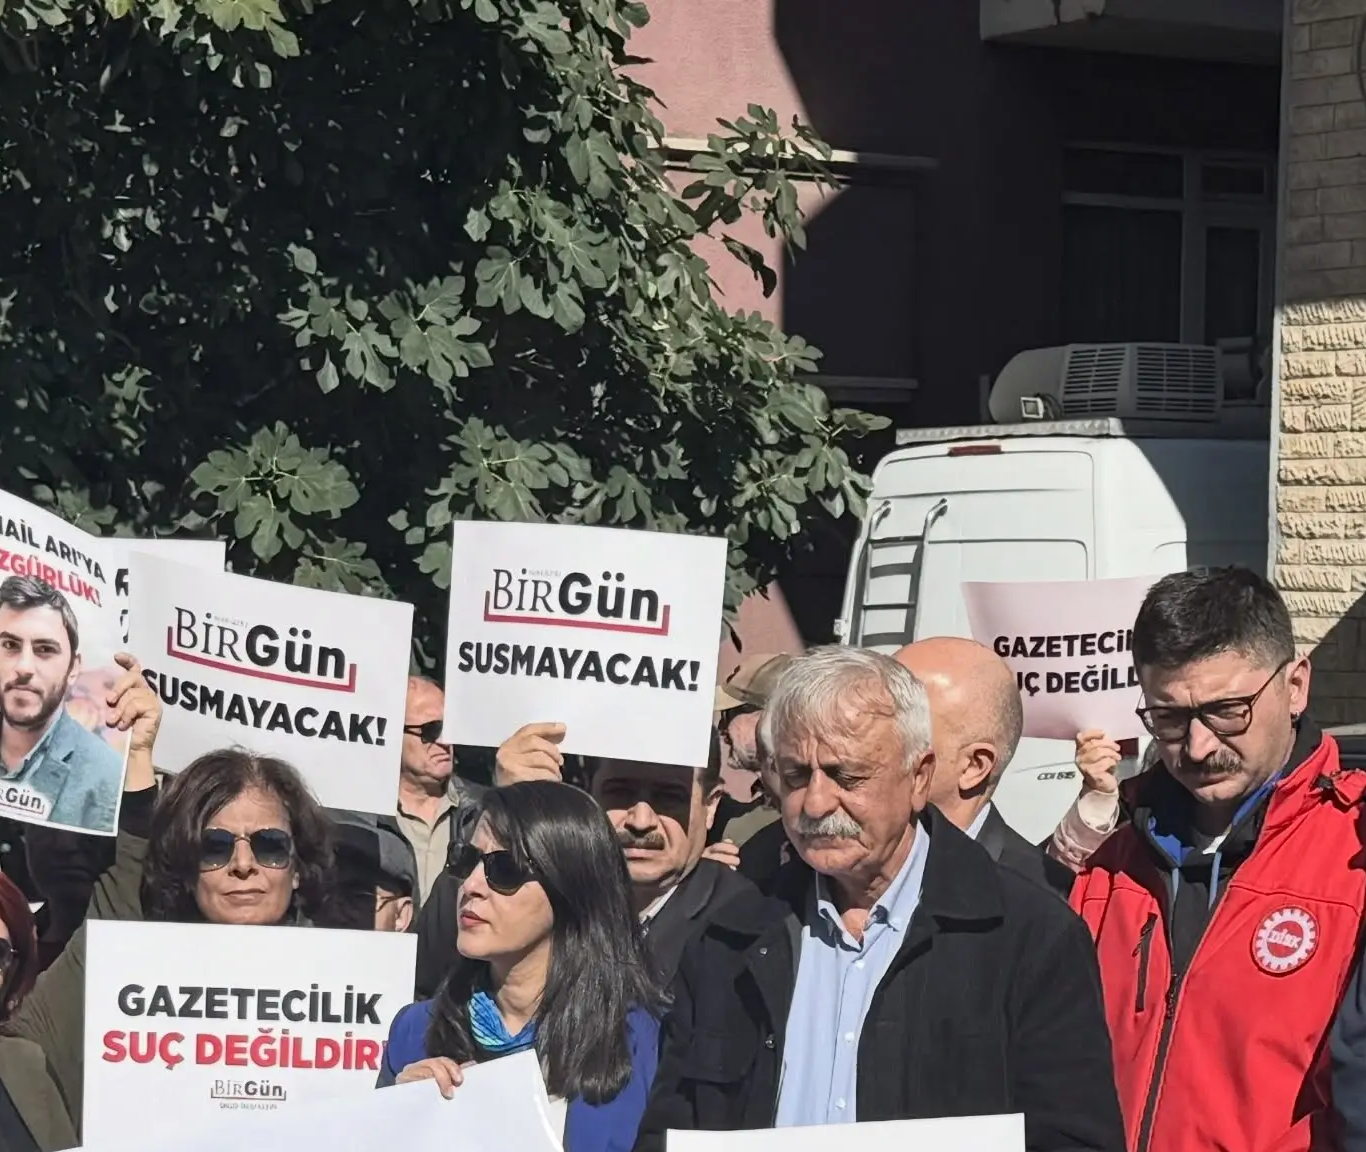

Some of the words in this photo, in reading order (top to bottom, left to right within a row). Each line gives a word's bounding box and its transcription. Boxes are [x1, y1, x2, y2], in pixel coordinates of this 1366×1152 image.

[45, 535, 107, 585] ARI'YA
[458, 641, 701, 692] SUSMAYACAK!
[141, 668, 387, 747] SUSMAYACAK!
[117, 983, 383, 1025] GAZETECİLİK
[101, 1030, 185, 1071] SUÇ
[195, 1028, 383, 1071] DEĞİLDİR
